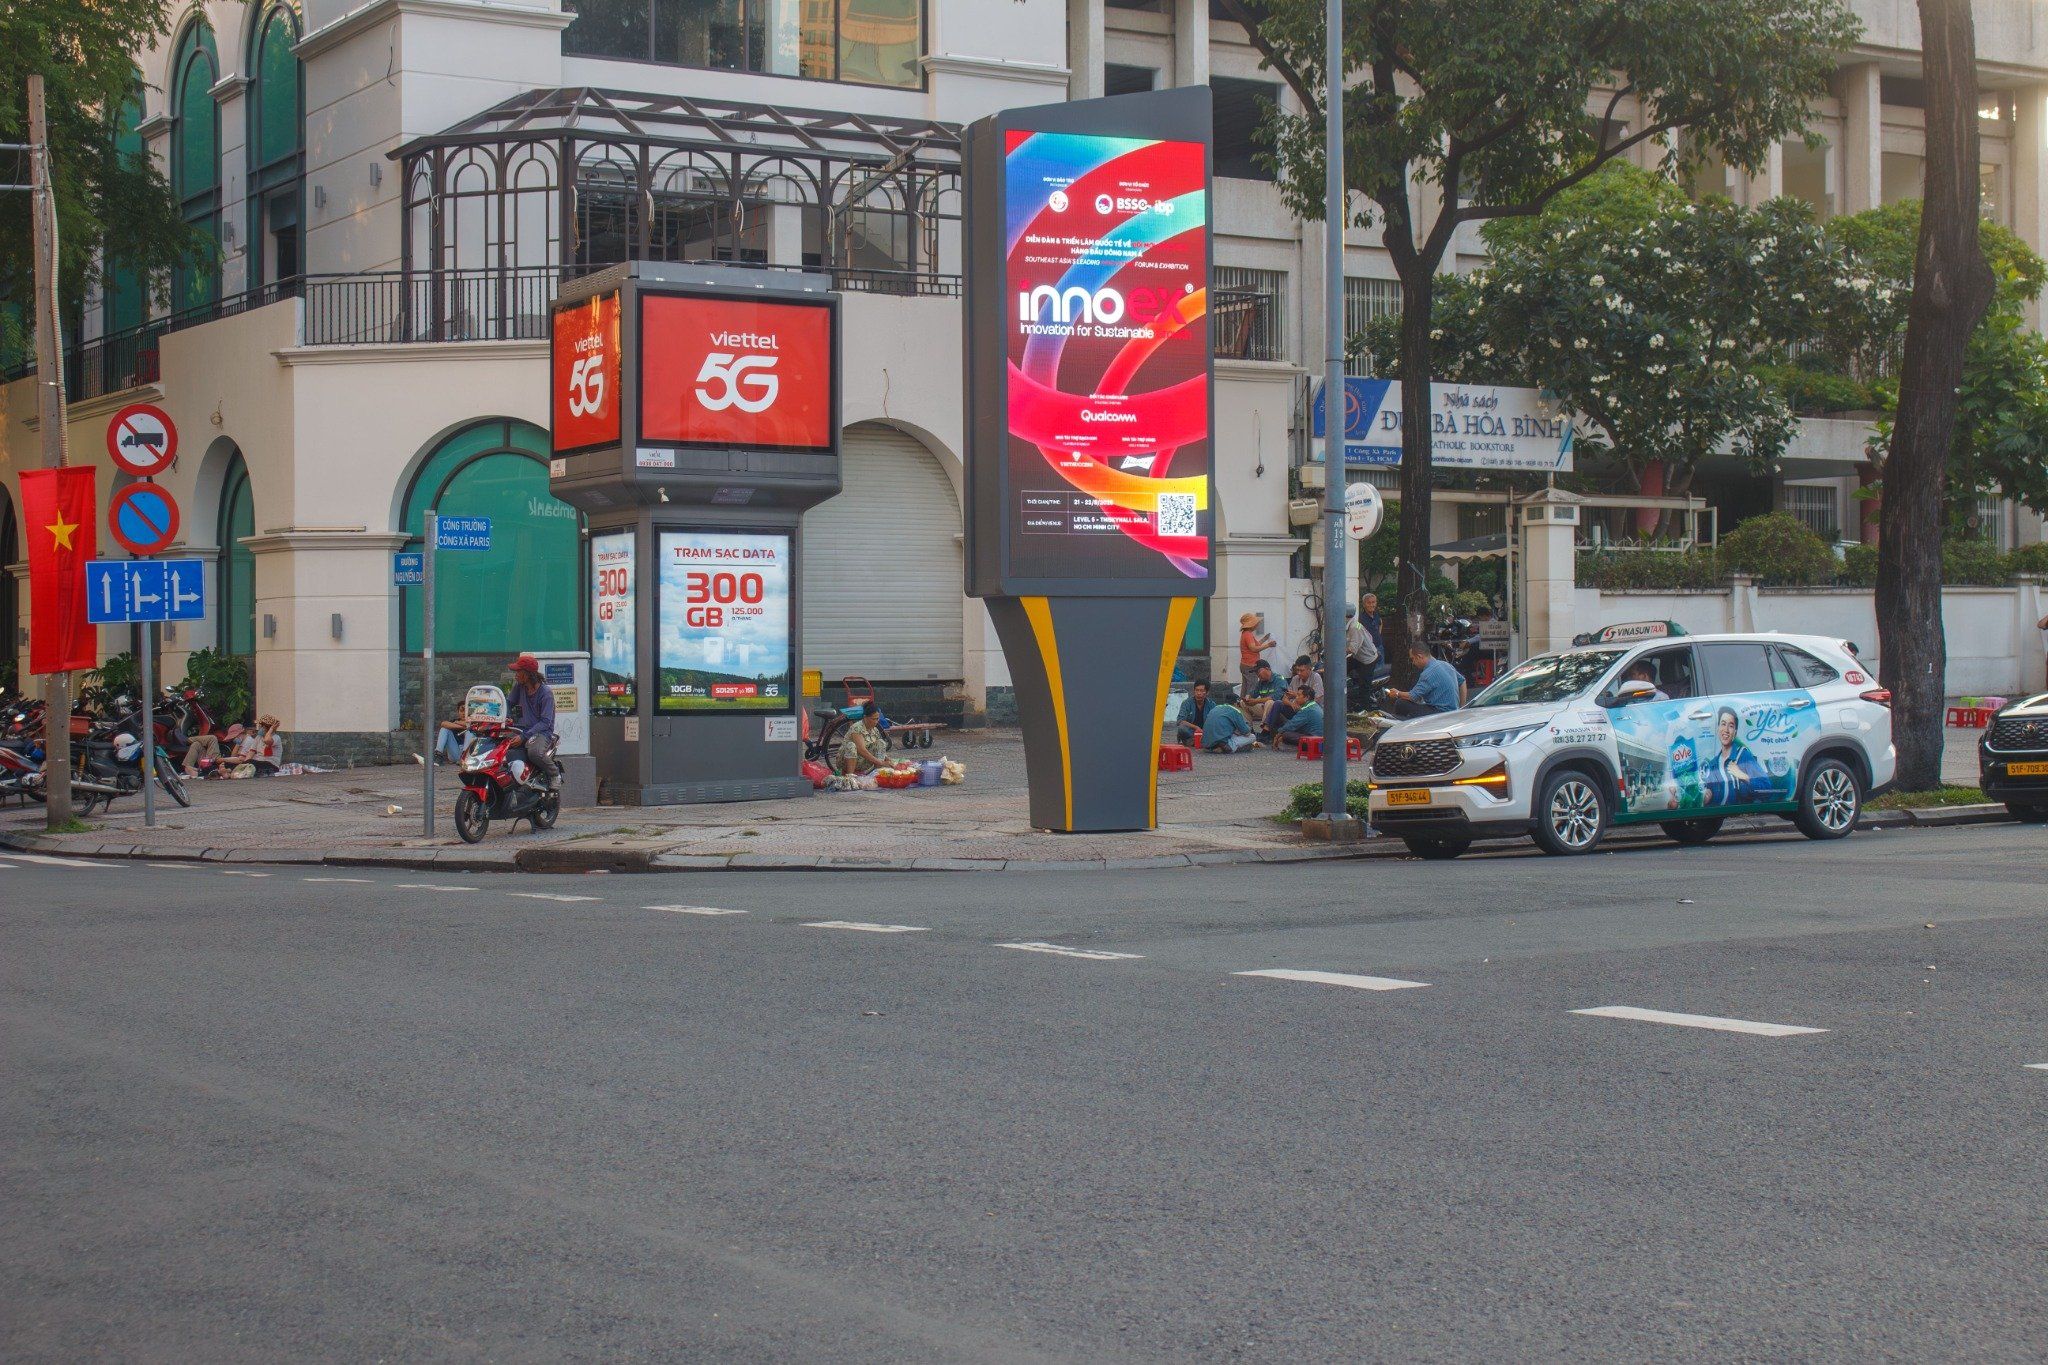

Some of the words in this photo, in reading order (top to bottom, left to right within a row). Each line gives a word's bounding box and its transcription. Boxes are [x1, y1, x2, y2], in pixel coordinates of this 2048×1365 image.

[710, 330, 779, 350] viettel
[1077, 326, 1092, 336] for
[1094, 326, 1154, 338] Sustainable
[575, 332, 604, 354] viettel
[569, 354, 604, 418] 5G
[695, 352, 778, 412] 5G
[1444, 386, 1469, 408] Nhà
[1472, 388, 1499, 411] sách
[1081, 410, 1137, 422] Qualcomm
[1431, 440, 1466, 450] ATHOLIC
[1470, 442, 1514, 452] BOOKSTORE
[442, 519, 460, 531] CÔNG
[438, 534, 458, 546] CÔNG
[470, 537, 490, 547] PARIS
[674, 548, 711, 559] TRẠM
[716, 549, 739, 559] SẠC
[743, 549, 775, 558] DATA
[599, 568, 627, 596] 300
[686, 572, 763, 604] 300
[600, 602, 613, 620] GB
[686, 607, 723, 627] GB
[1618, 626, 1650, 636] VINASUN
[1651, 625, 1664, 633] TAXI
[765, 687, 778, 697] 5G
